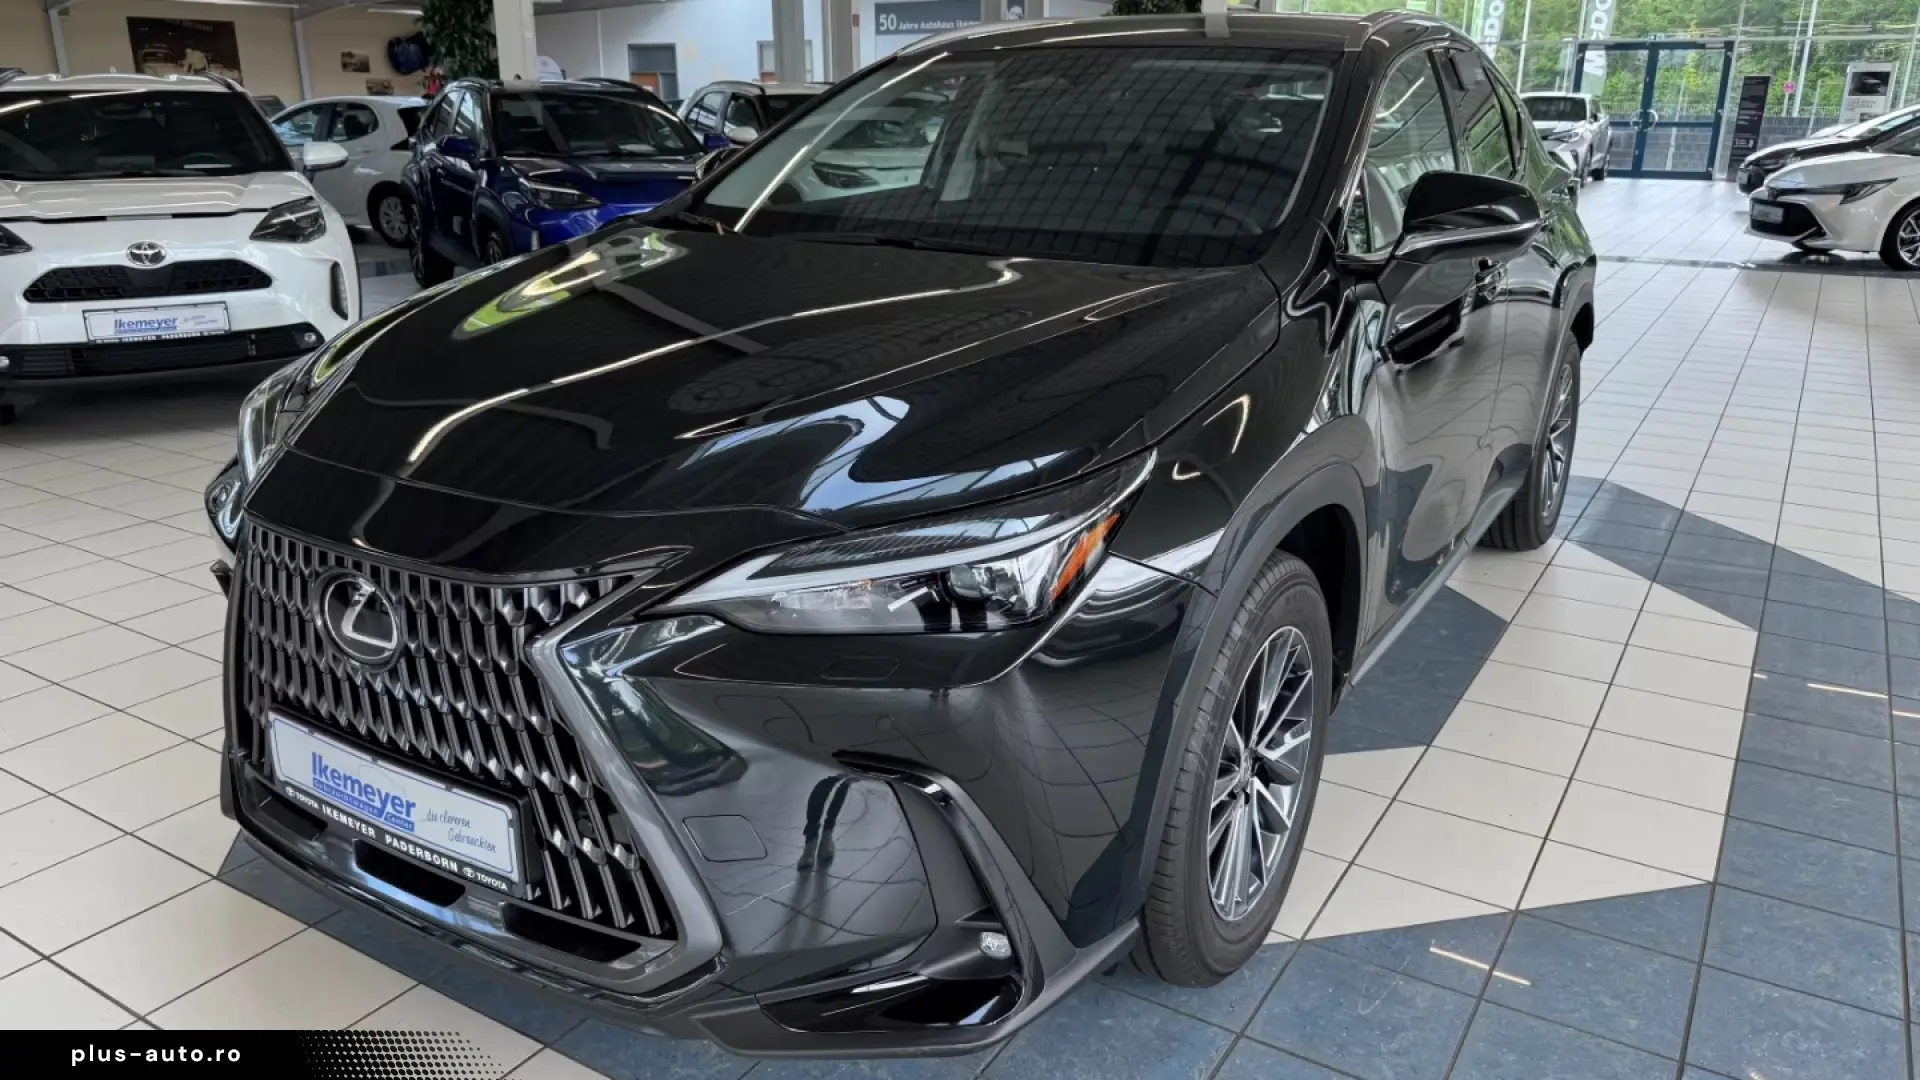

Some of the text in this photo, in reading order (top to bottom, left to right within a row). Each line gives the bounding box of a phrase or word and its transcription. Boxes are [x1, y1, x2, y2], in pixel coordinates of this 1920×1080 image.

[879, 14, 897, 31] 50
[898, 20, 918, 30] Jahre
[920, 19, 955, 29] Autohaus
[114, 317, 178, 331] Ikemeyer
[312, 751, 416, 819] Ikemeyer
[295, 791, 508, 892] TOYOTA IKEMEYER PADERBORN TOYOTA
